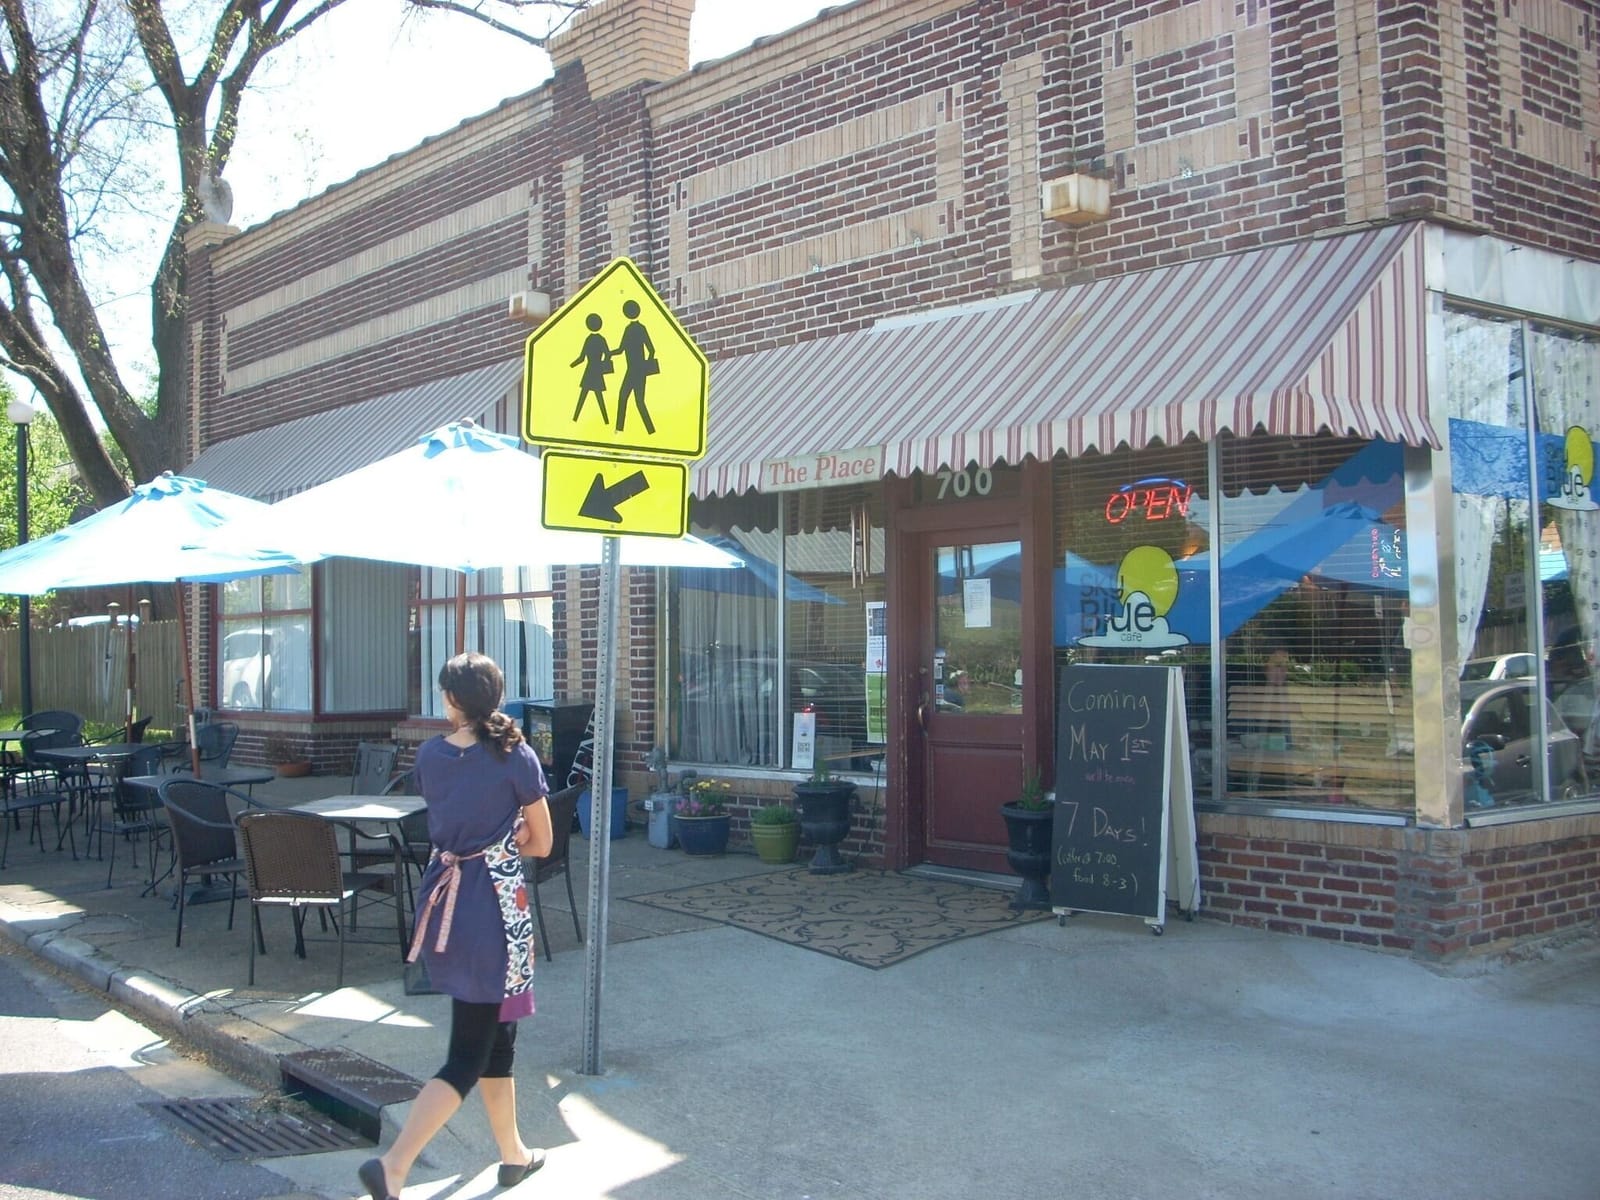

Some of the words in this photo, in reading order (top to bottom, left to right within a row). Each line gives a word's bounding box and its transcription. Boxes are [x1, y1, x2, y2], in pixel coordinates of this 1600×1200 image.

[768, 462, 807, 486] The
[814, 455, 875, 481] Place
[936, 468, 993, 500] 700
[1104, 484, 1193, 524] OPEN
[1081, 599, 1155, 634] Blue
[1120, 632, 1143, 642] cafe
[1068, 681, 1150, 730] Coming
[1068, 722, 1108, 761] MAY
[1061, 801, 1079, 837] 7
